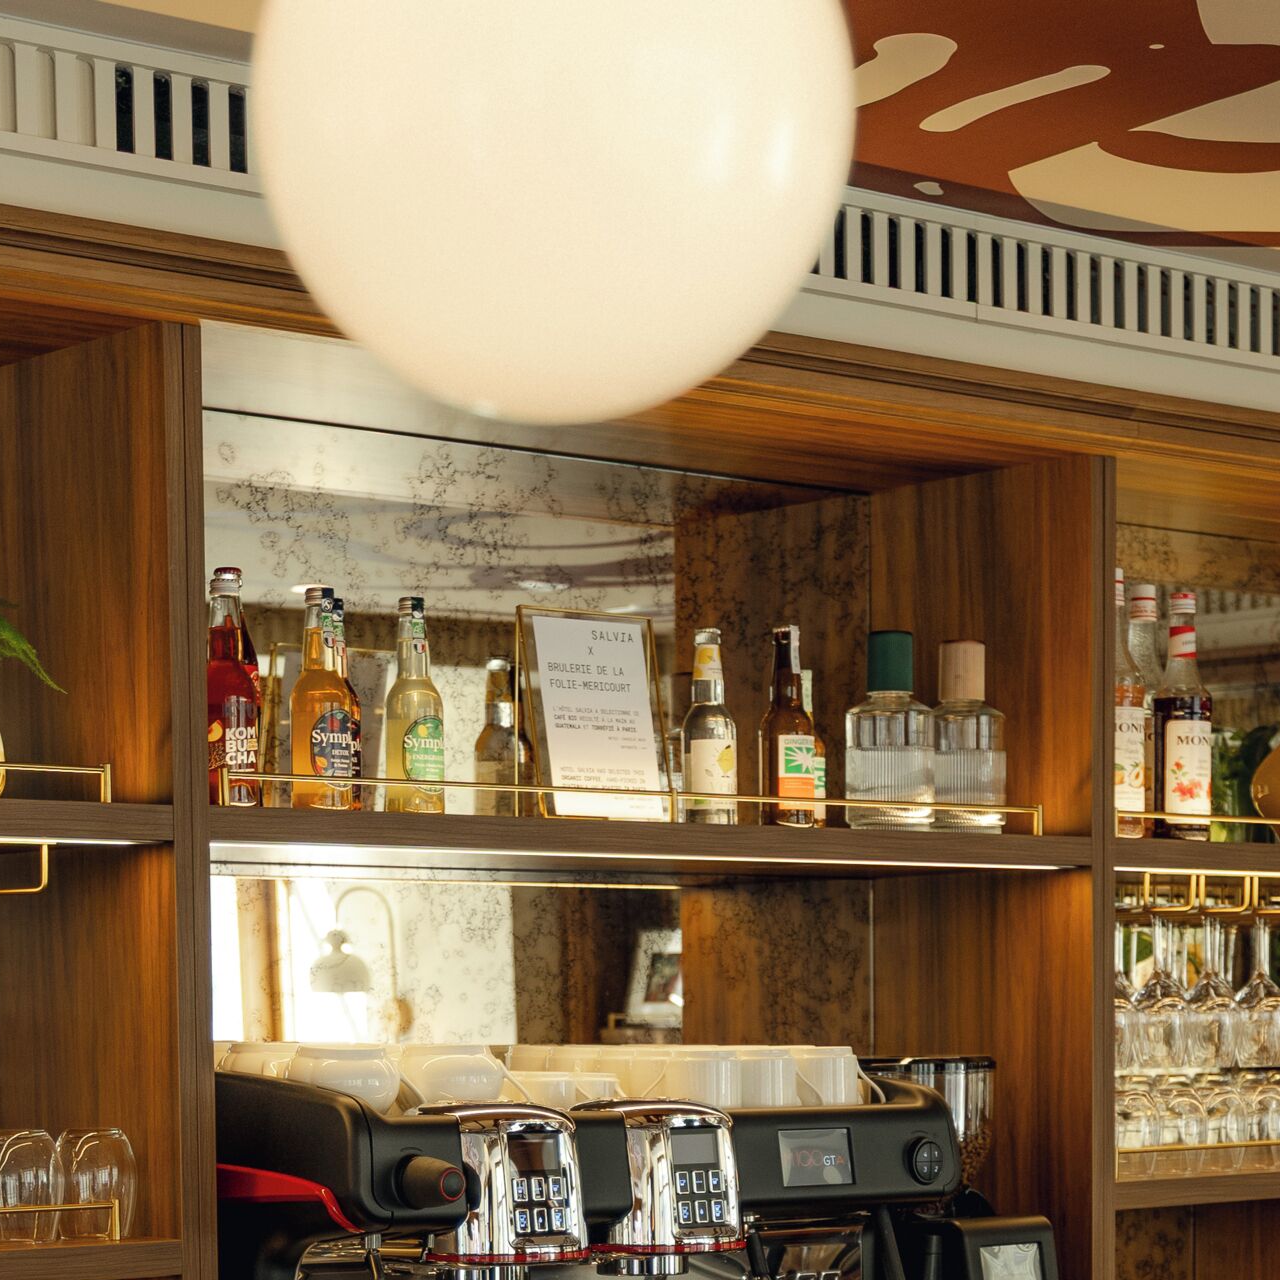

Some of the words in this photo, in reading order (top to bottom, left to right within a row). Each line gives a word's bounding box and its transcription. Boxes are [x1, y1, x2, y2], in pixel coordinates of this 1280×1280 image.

[591, 630, 634, 643] SALVIA
[587, 646, 594, 655] X
[547, 662, 592, 674] BRULERIE
[596, 665, 607, 676] DE
[613, 667, 624, 676] LA
[550, 679, 631, 693] FOLIE-MERICOURT
[225, 727, 256, 740] KOM
[225, 739, 247, 752] BU
[225, 752, 256, 765] CHA
